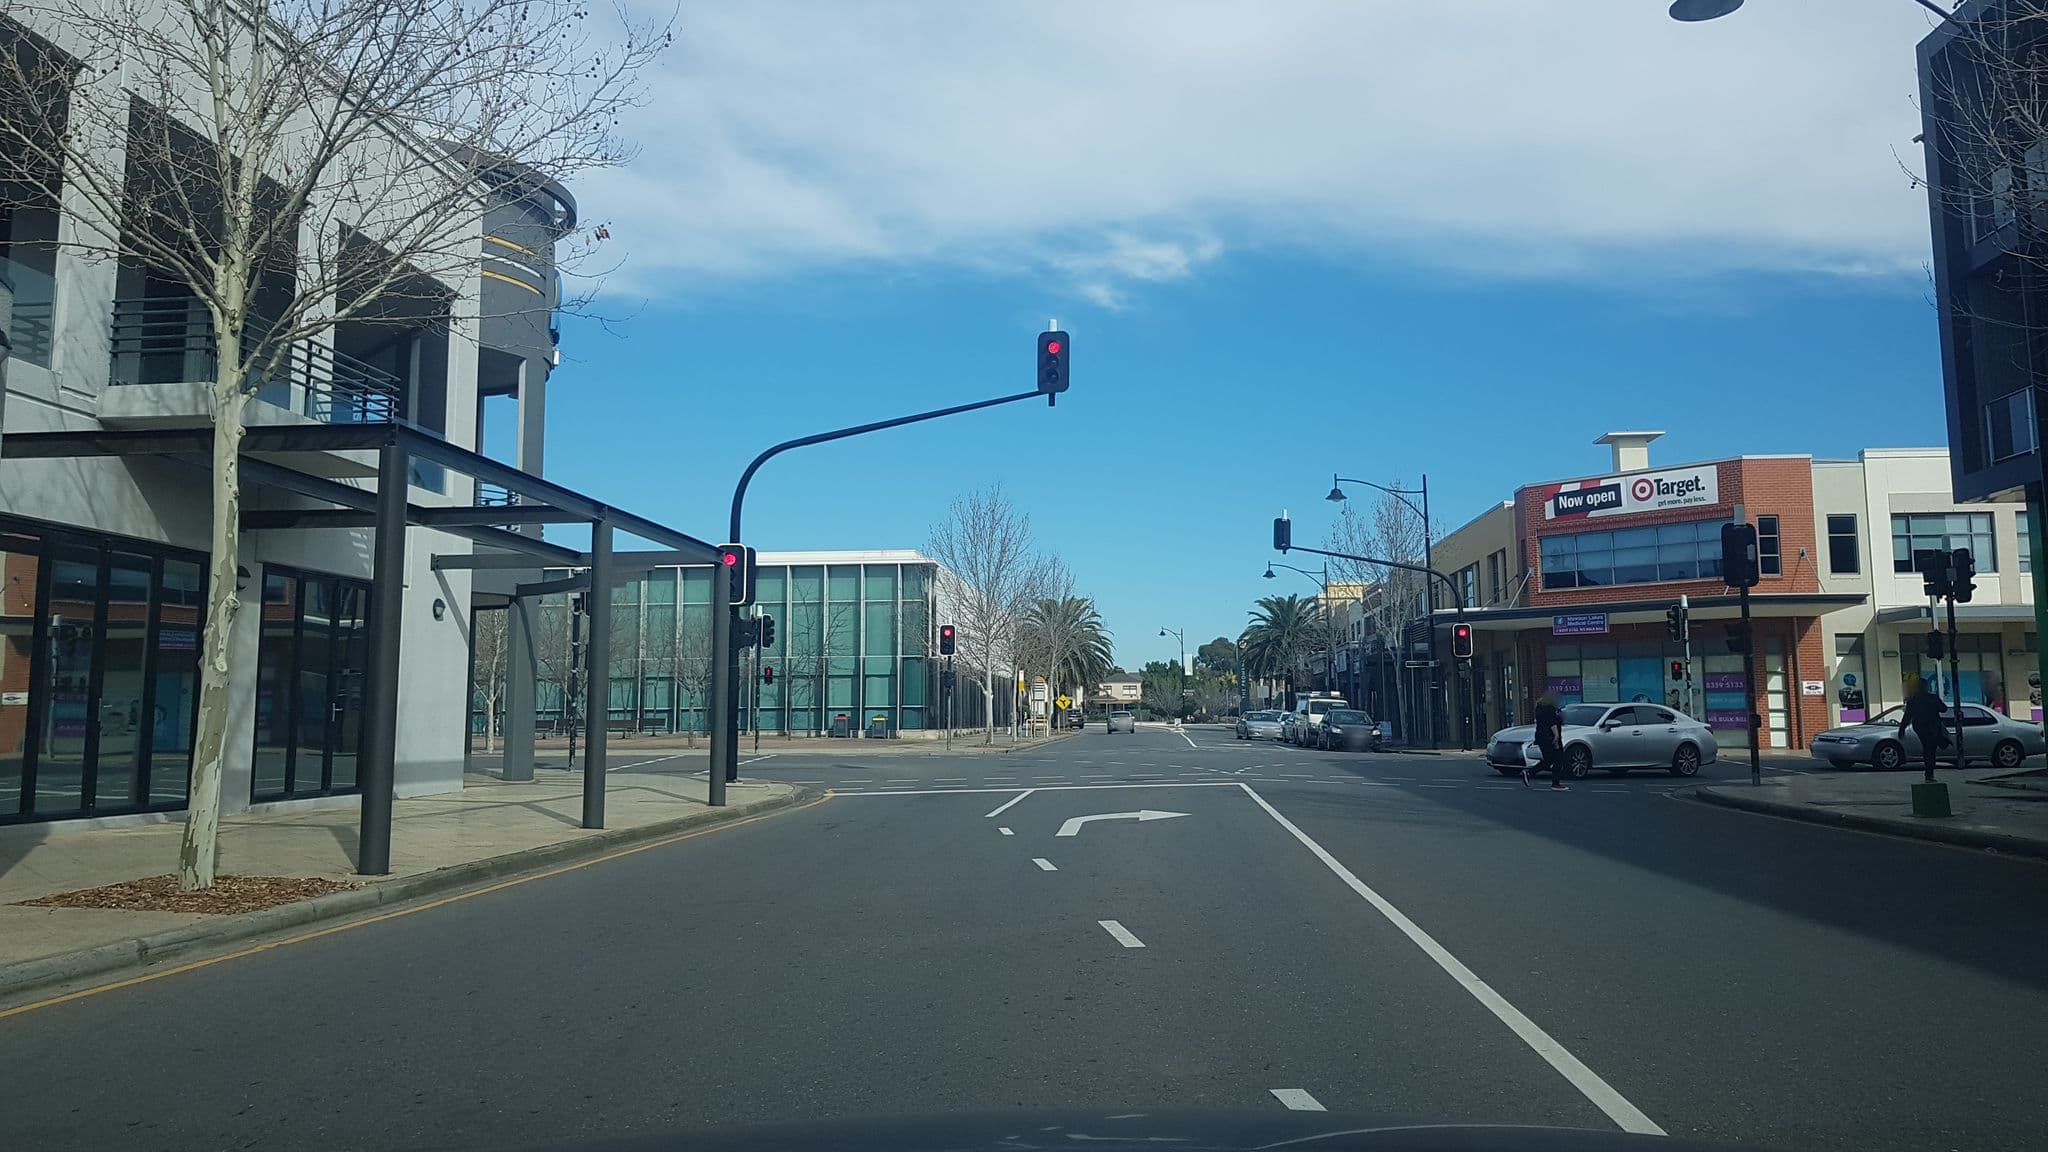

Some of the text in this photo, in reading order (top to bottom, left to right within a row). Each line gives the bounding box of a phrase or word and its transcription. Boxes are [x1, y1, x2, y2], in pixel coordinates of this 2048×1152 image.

[1558, 490, 1616, 510] Now open
[1657, 500, 1667, 508] get
